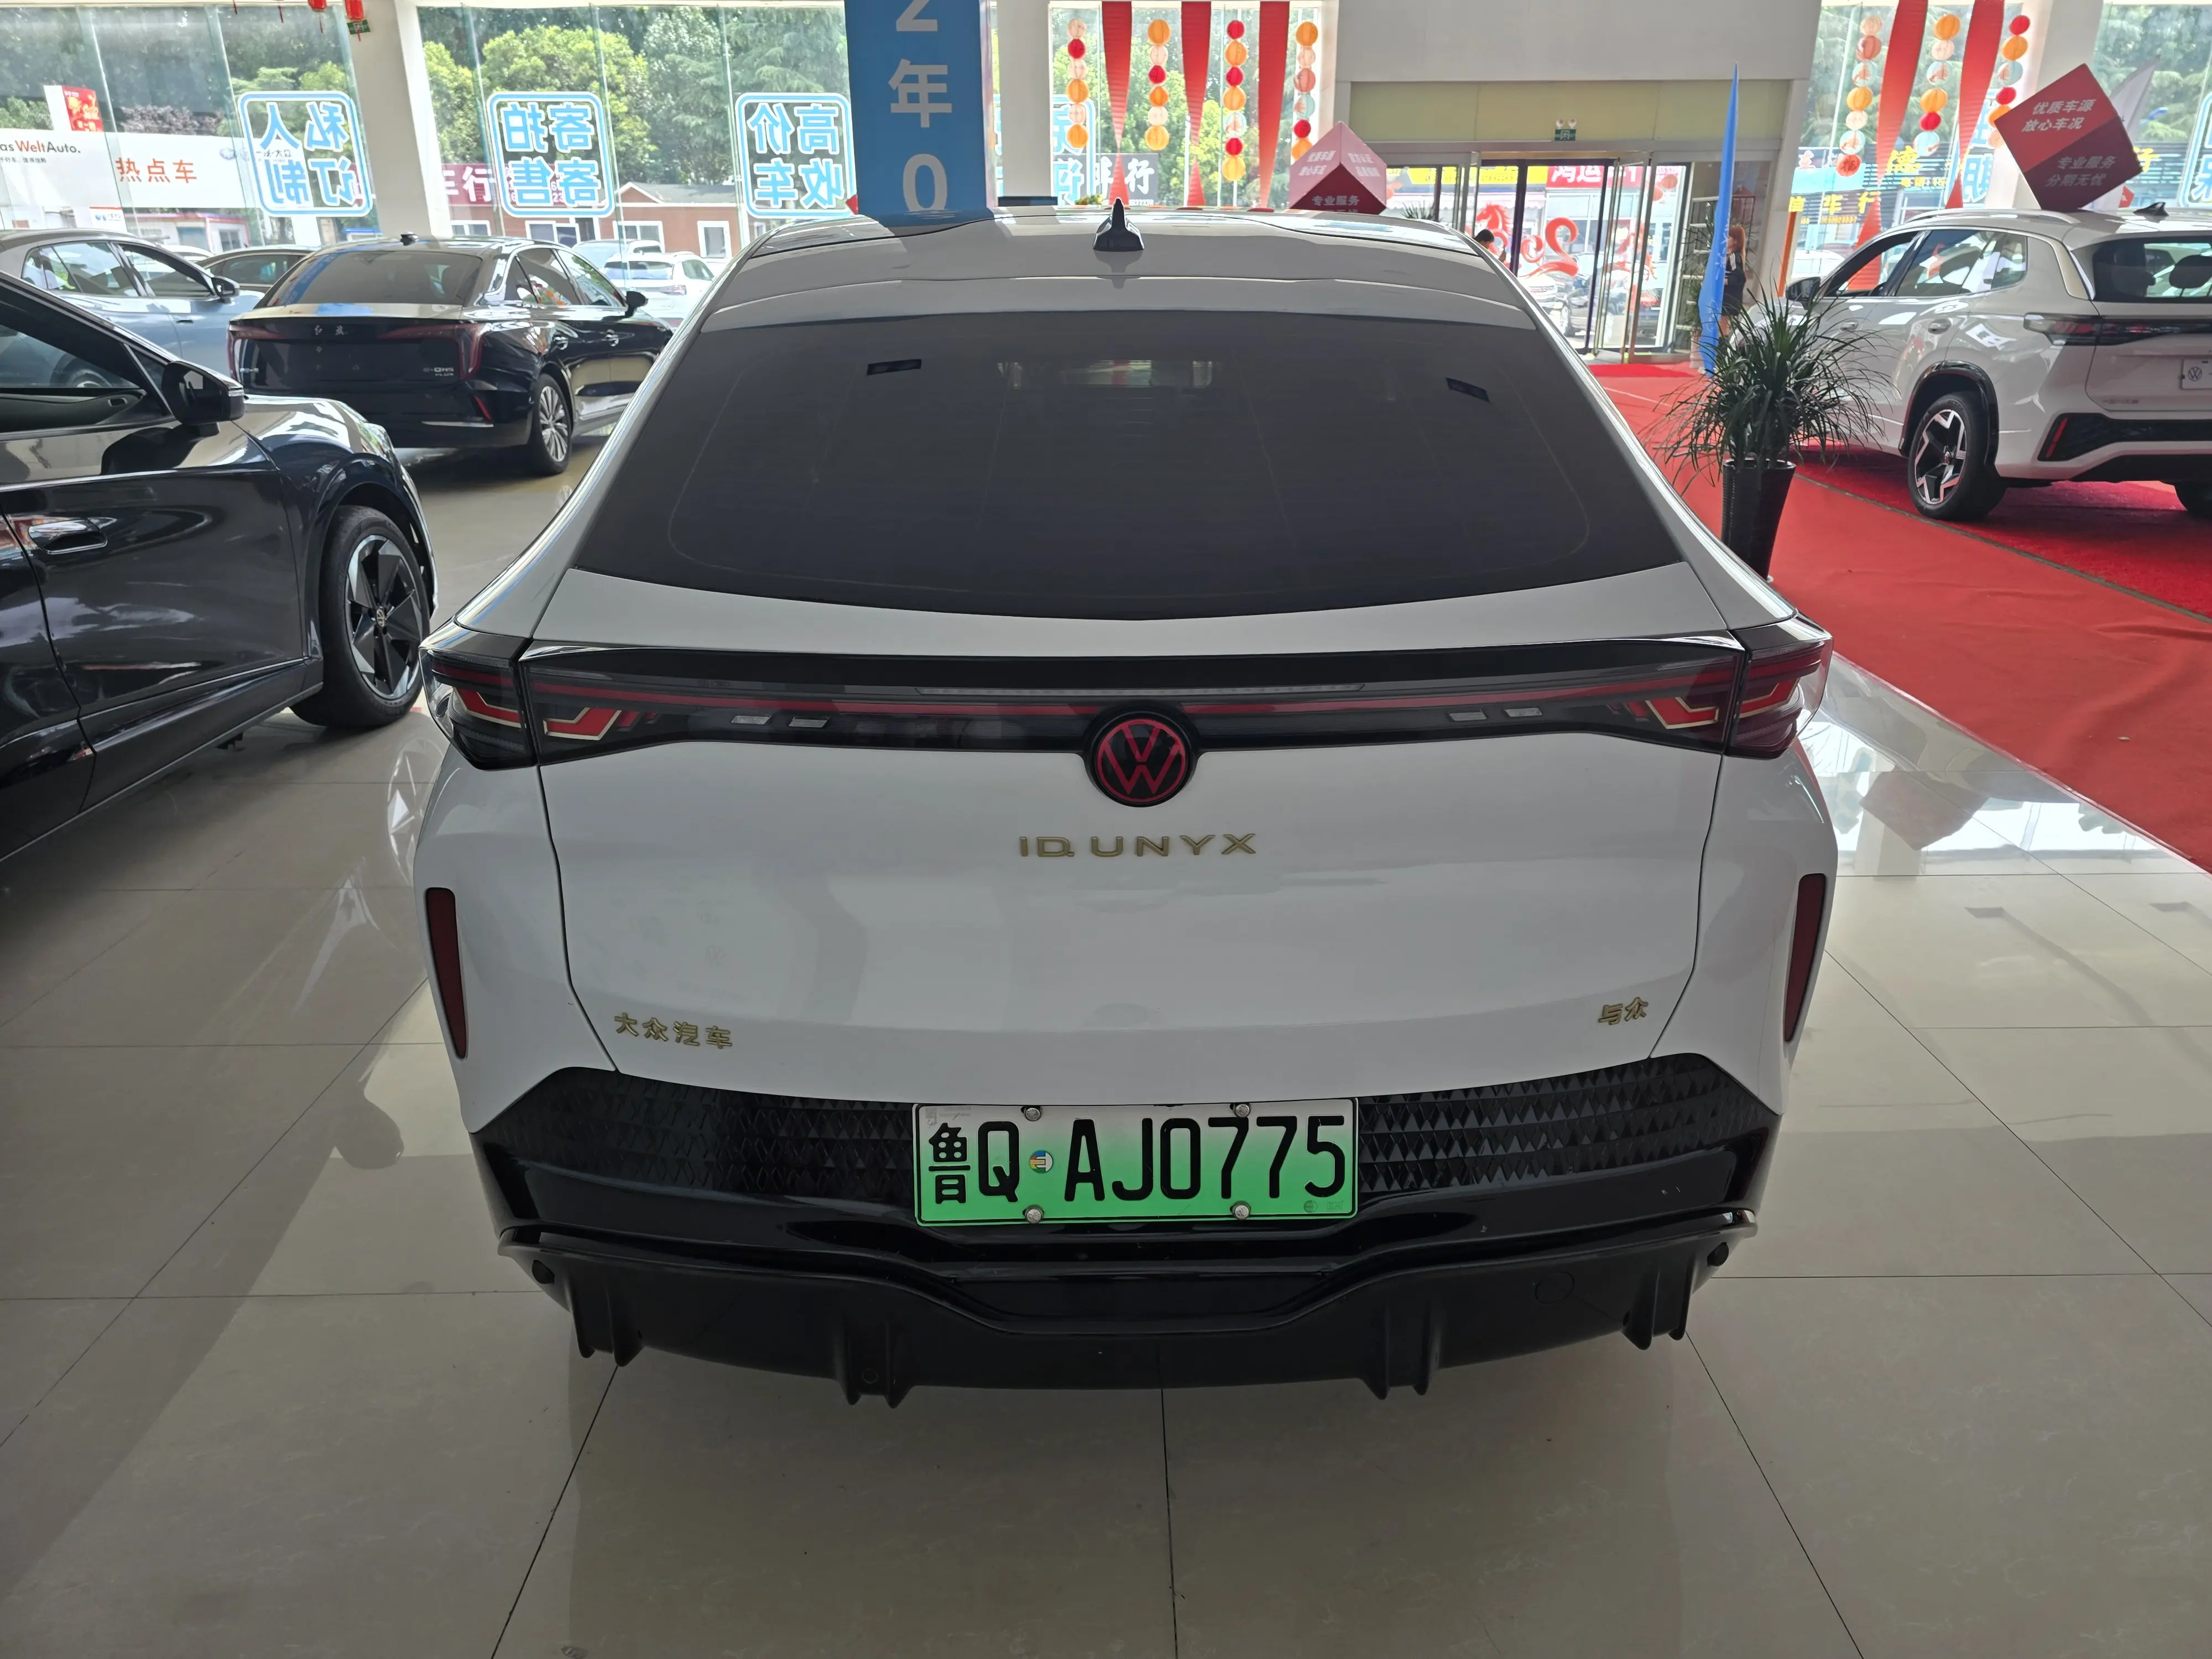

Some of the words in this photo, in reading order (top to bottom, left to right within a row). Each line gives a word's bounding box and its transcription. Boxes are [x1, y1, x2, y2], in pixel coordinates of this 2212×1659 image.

[2032, 99, 2096, 115] 优质车源
[2022, 117, 2084, 132] 放心车况
[15, 140, 81, 153] WeltAuto.
[2058, 155, 2116, 170] 专业服务
[116, 158, 197, 184] 热点车
[2045, 174, 2106, 187] 分期无忧
[1312, 195, 1360, 206] 专业服务
[1091, 833, 1256, 857] UNYX
[1598, 997, 1648, 1025] 与众
[614, 1012, 733, 1049] 大众汽车
[928, 1121, 1020, 1204] 鲁Q
[1064, 1115, 1345, 1202] AJ0775
